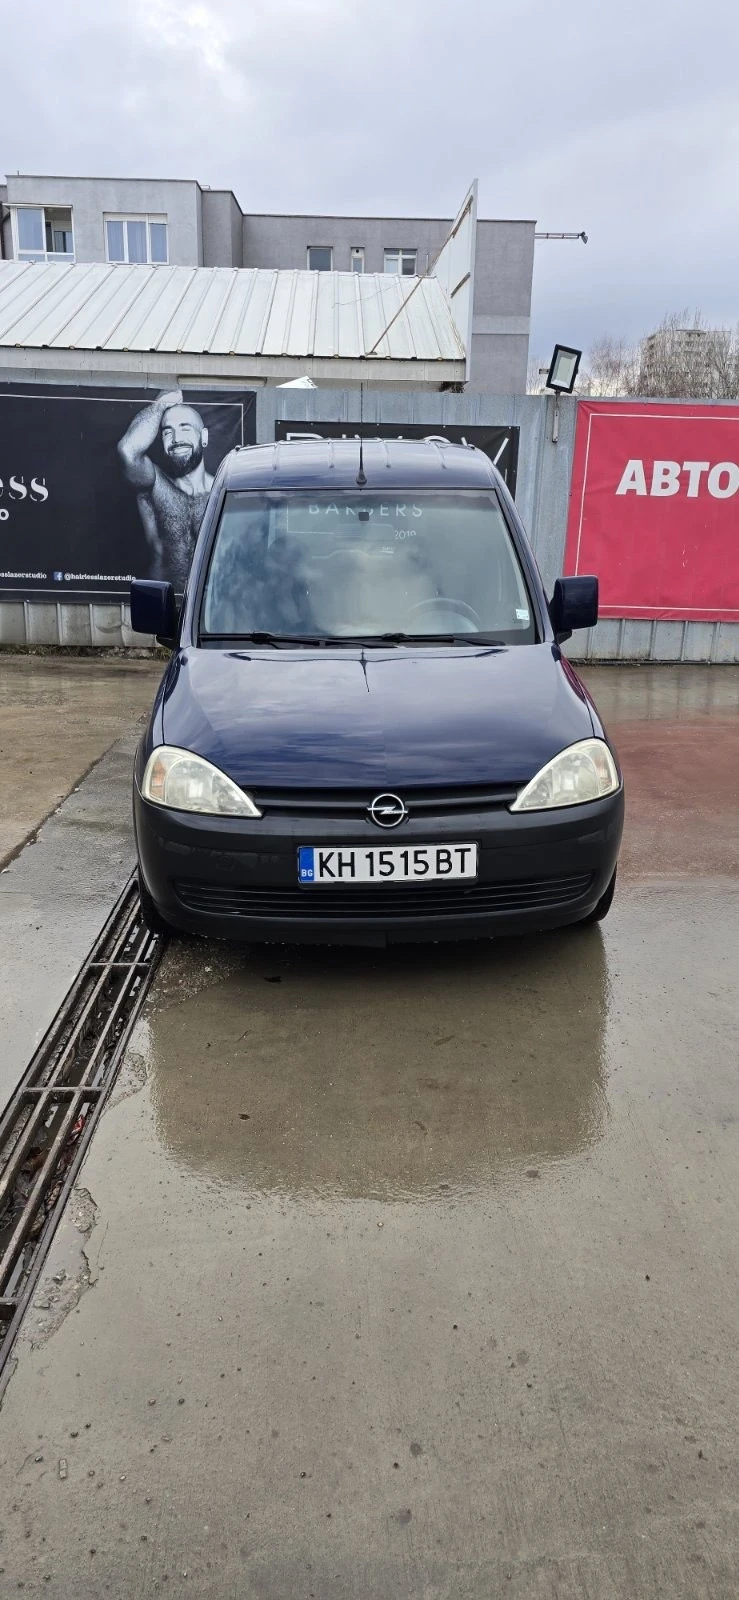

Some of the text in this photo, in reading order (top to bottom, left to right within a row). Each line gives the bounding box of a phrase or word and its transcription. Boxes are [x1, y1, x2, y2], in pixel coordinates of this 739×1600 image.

[0, 475, 49, 502] ss
[615, 459, 739, 499] АВТО
[301, 869, 314, 877] BG
[319, 848, 472, 878] KH 1515 BT
